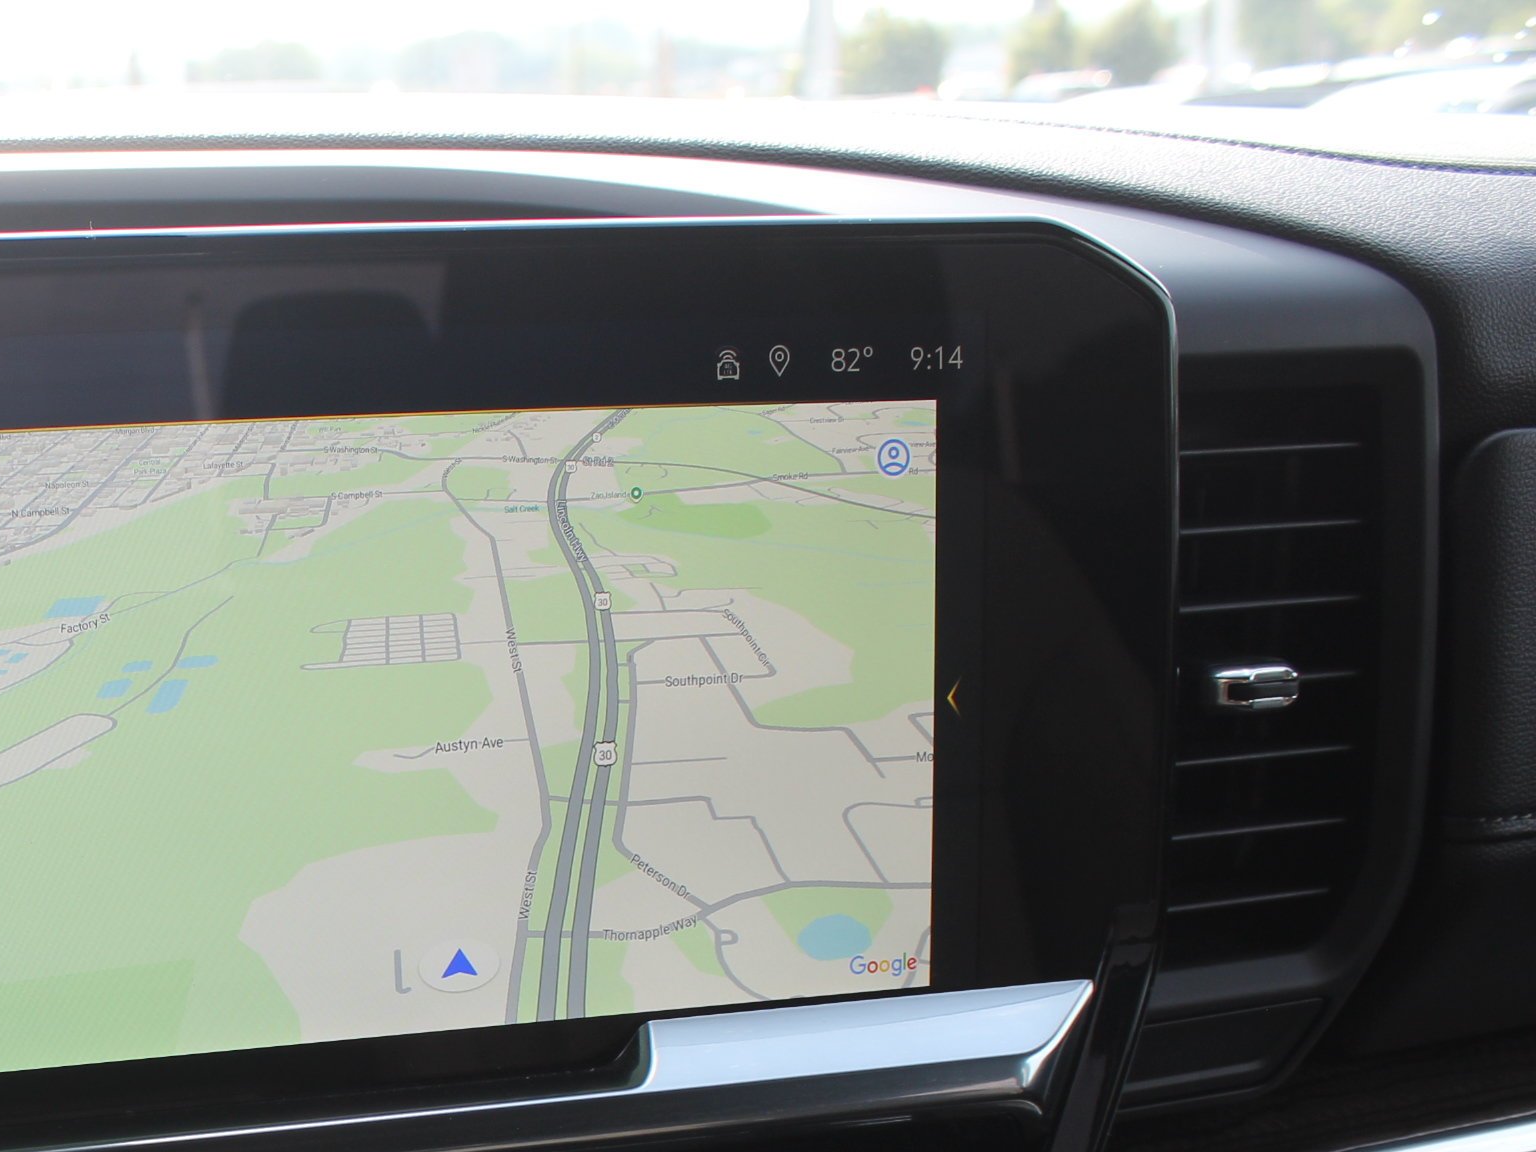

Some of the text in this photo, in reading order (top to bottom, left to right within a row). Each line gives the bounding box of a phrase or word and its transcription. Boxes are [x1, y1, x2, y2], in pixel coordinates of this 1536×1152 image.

[910, 345, 964, 371] 9:14
[115, 428, 139, 437] Morgan
[324, 446, 329, 454] S
[329, 446, 370, 455] Washington
[139, 458, 161, 466] Central
[202, 461, 235, 471] Lafayette
[502, 455, 558, 466] S Washington St
[594, 456, 606, 467] Rd
[607, 456, 614, 468] 2
[133, 468, 148, 476] Park
[908, 467, 919, 475] Rd
[773, 472, 808, 482] Smoke Rd
[45, 480, 89, 490] Napoleon St
[331, 490, 383, 502] S Campbell St
[11, 507, 70, 518] N Campbell St
[504, 505, 539, 514] Salt Creek
[556, 500, 587, 562] Lincoln Hwy
[597, 598, 608, 607] 30
[60, 612, 111, 634] Factory St
[722, 608, 770, 668] Southpoint Cir
[505, 627, 522, 674] West St
[664, 672, 744, 688] Southpoint Dr
[435, 736, 504, 754] Austyn Ave
[598, 750, 612, 761] 30
[630, 853, 691, 900] Peterson Dr
[518, 870, 537, 920] West St
[602, 915, 698, 942] Thornapple Way
[849, 952, 918, 977] Google
